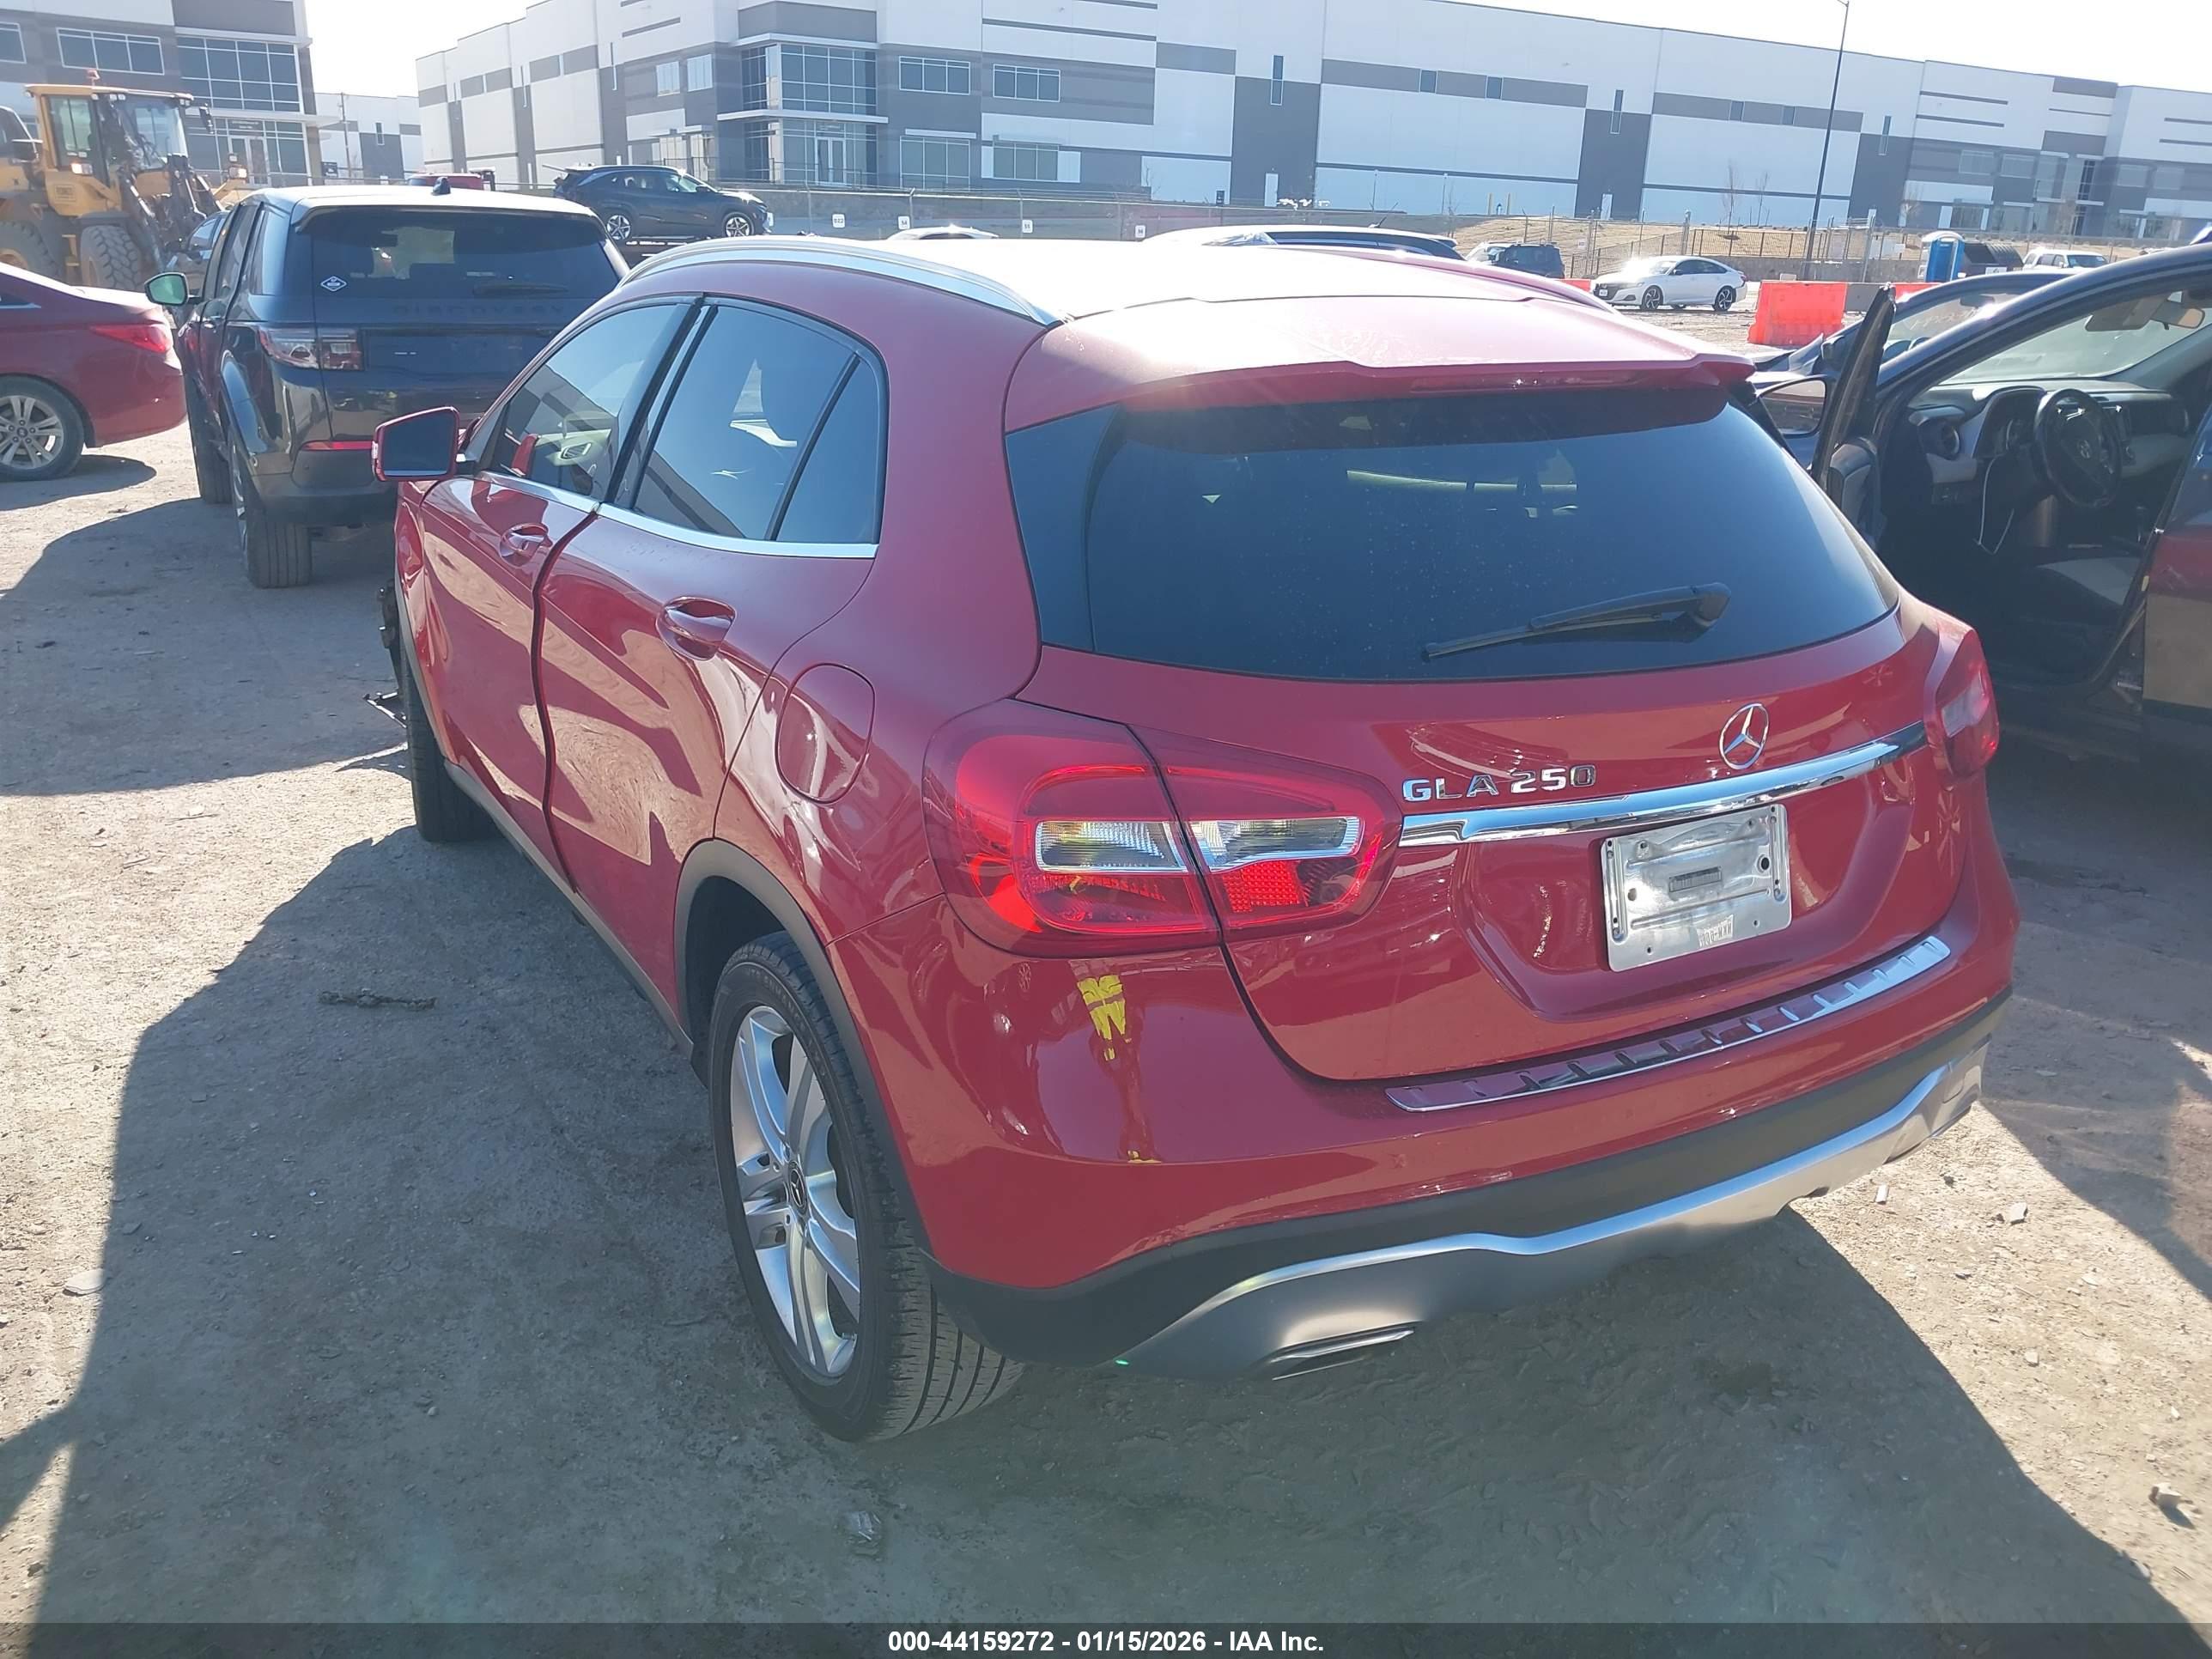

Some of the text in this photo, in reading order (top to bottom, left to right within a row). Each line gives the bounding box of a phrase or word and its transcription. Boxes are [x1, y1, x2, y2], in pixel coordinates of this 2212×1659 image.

[392, 304, 564, 316] DISCOVERY
[1402, 764, 1596, 802] GLA 250
